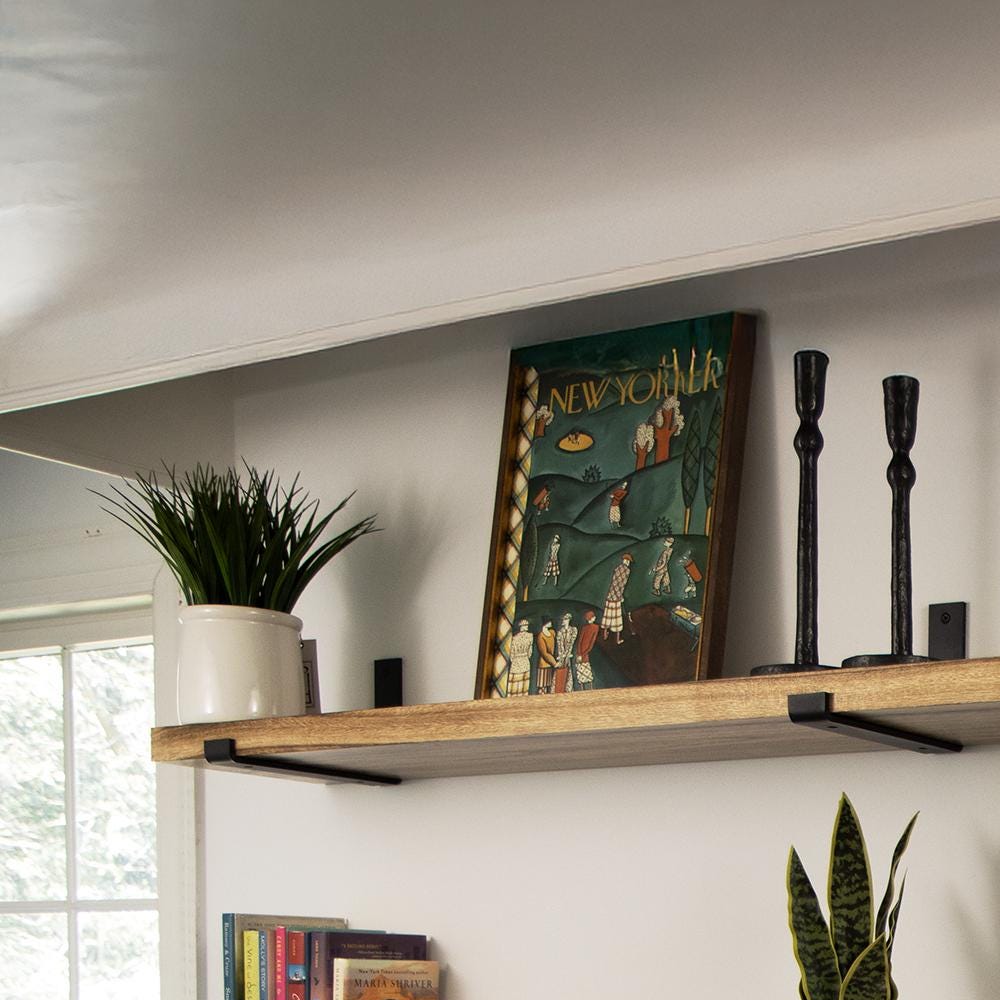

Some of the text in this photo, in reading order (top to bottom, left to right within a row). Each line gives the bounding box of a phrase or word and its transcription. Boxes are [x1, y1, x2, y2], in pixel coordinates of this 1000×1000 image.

[550, 376, 611, 414] NEW
[353, 978, 433, 989] MARIA SHRIVER
